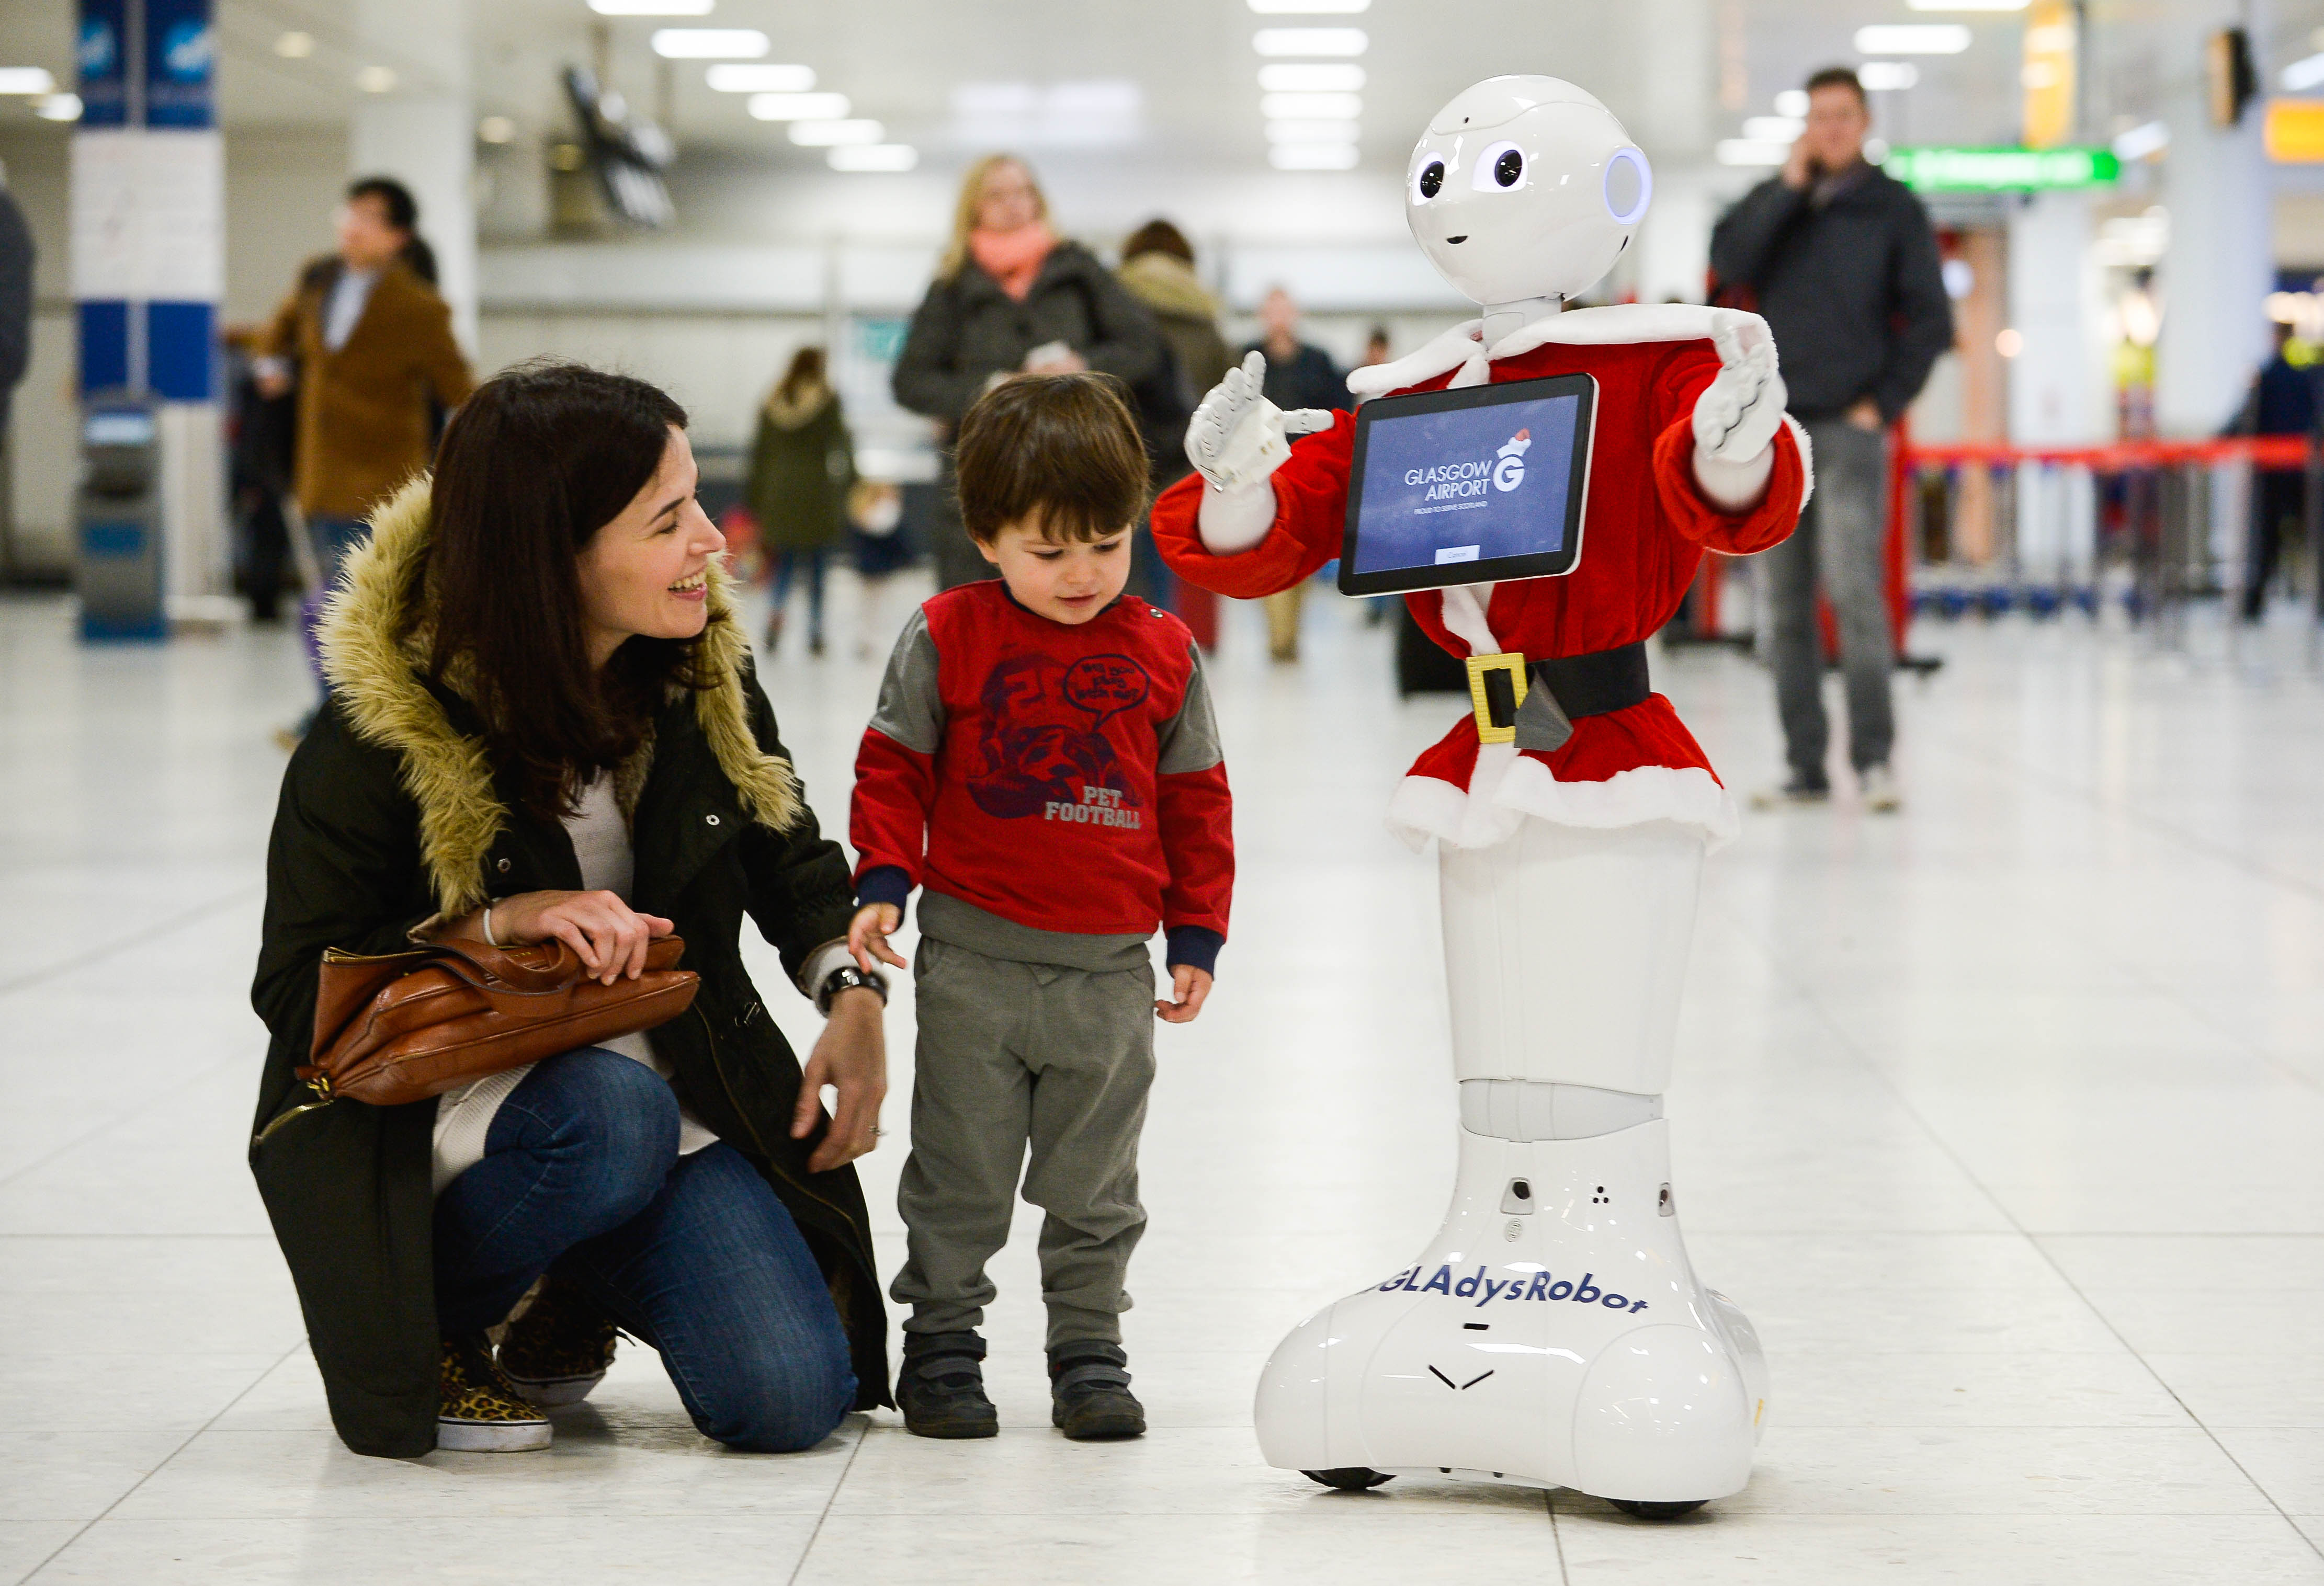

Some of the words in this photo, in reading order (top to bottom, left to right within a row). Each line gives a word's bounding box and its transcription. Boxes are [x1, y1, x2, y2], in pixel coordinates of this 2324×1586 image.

[1404, 460, 1493, 486] GLASGOW
[1493, 456, 1525, 493] G
[1424, 478, 1491, 502] AIRPORT
[1083, 785, 1123, 808] PET
[1045, 801, 1141, 830] FOOTBALL
